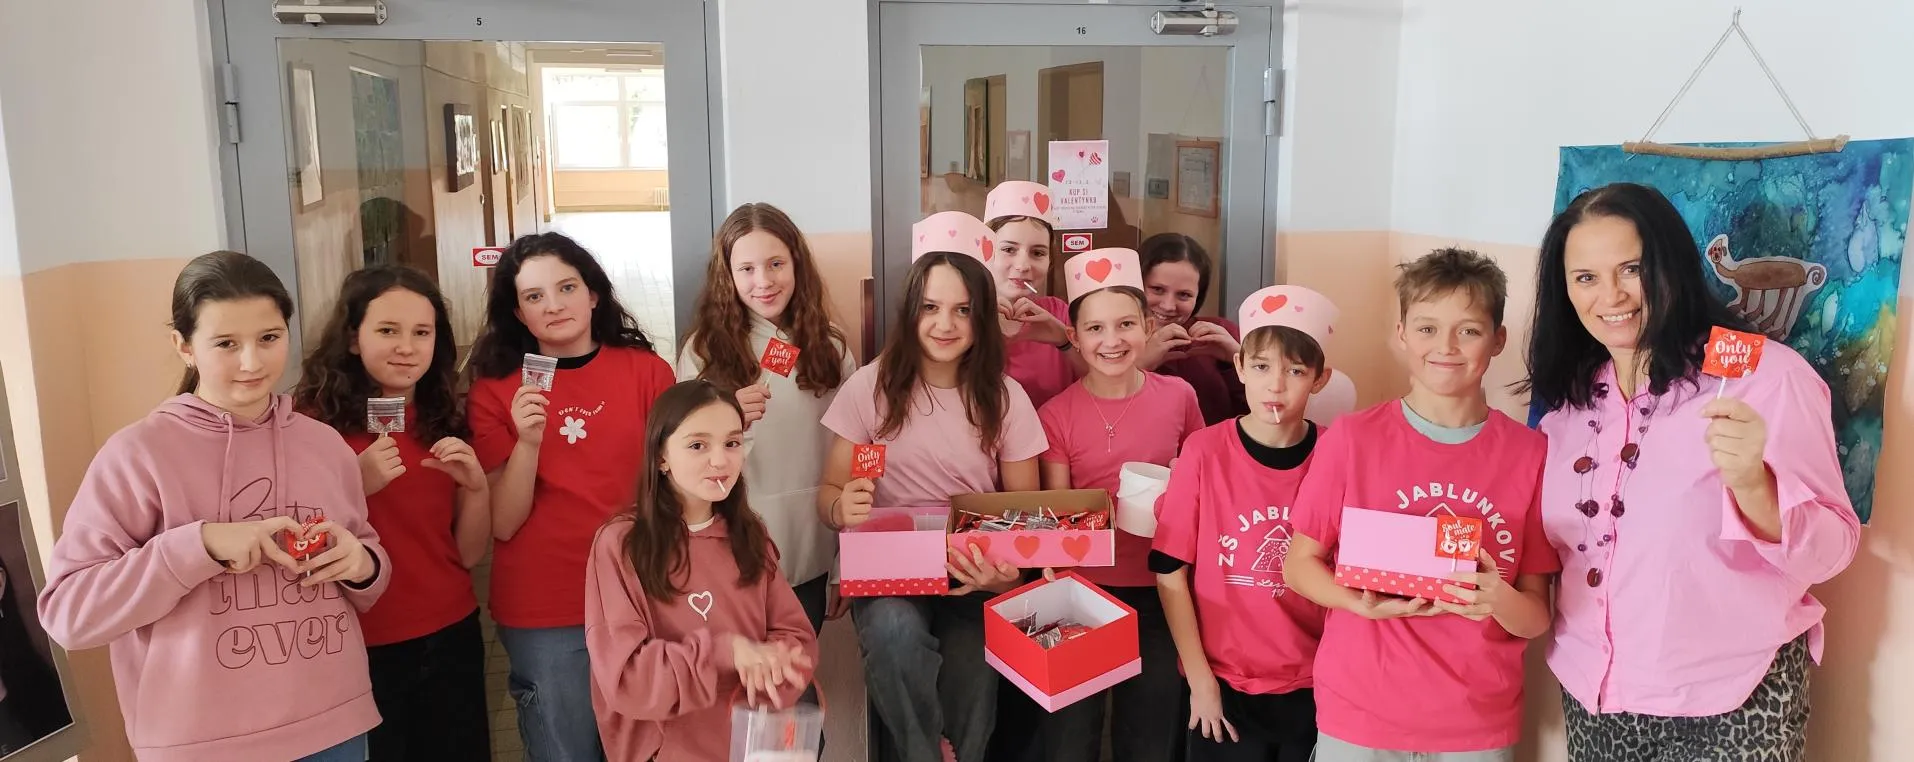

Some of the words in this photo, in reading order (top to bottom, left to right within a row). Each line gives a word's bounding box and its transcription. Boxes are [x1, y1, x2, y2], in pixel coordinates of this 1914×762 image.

[476, 17, 482, 26] 5
[1076, 26, 1087, 35] 16
[770, 346, 792, 360] Only
[1715, 340, 1753, 357] Only
[771, 357, 789, 367] you
[1720, 354, 1750, 369] you
[857, 449, 880, 463] Only
[861, 459, 880, 471] you
[1396, 482, 1516, 564] JABLUNKOV
[1217, 534, 1239, 568] ZŠ
[1238, 506, 1290, 532] JABL
[216, 611, 349, 669] ever
